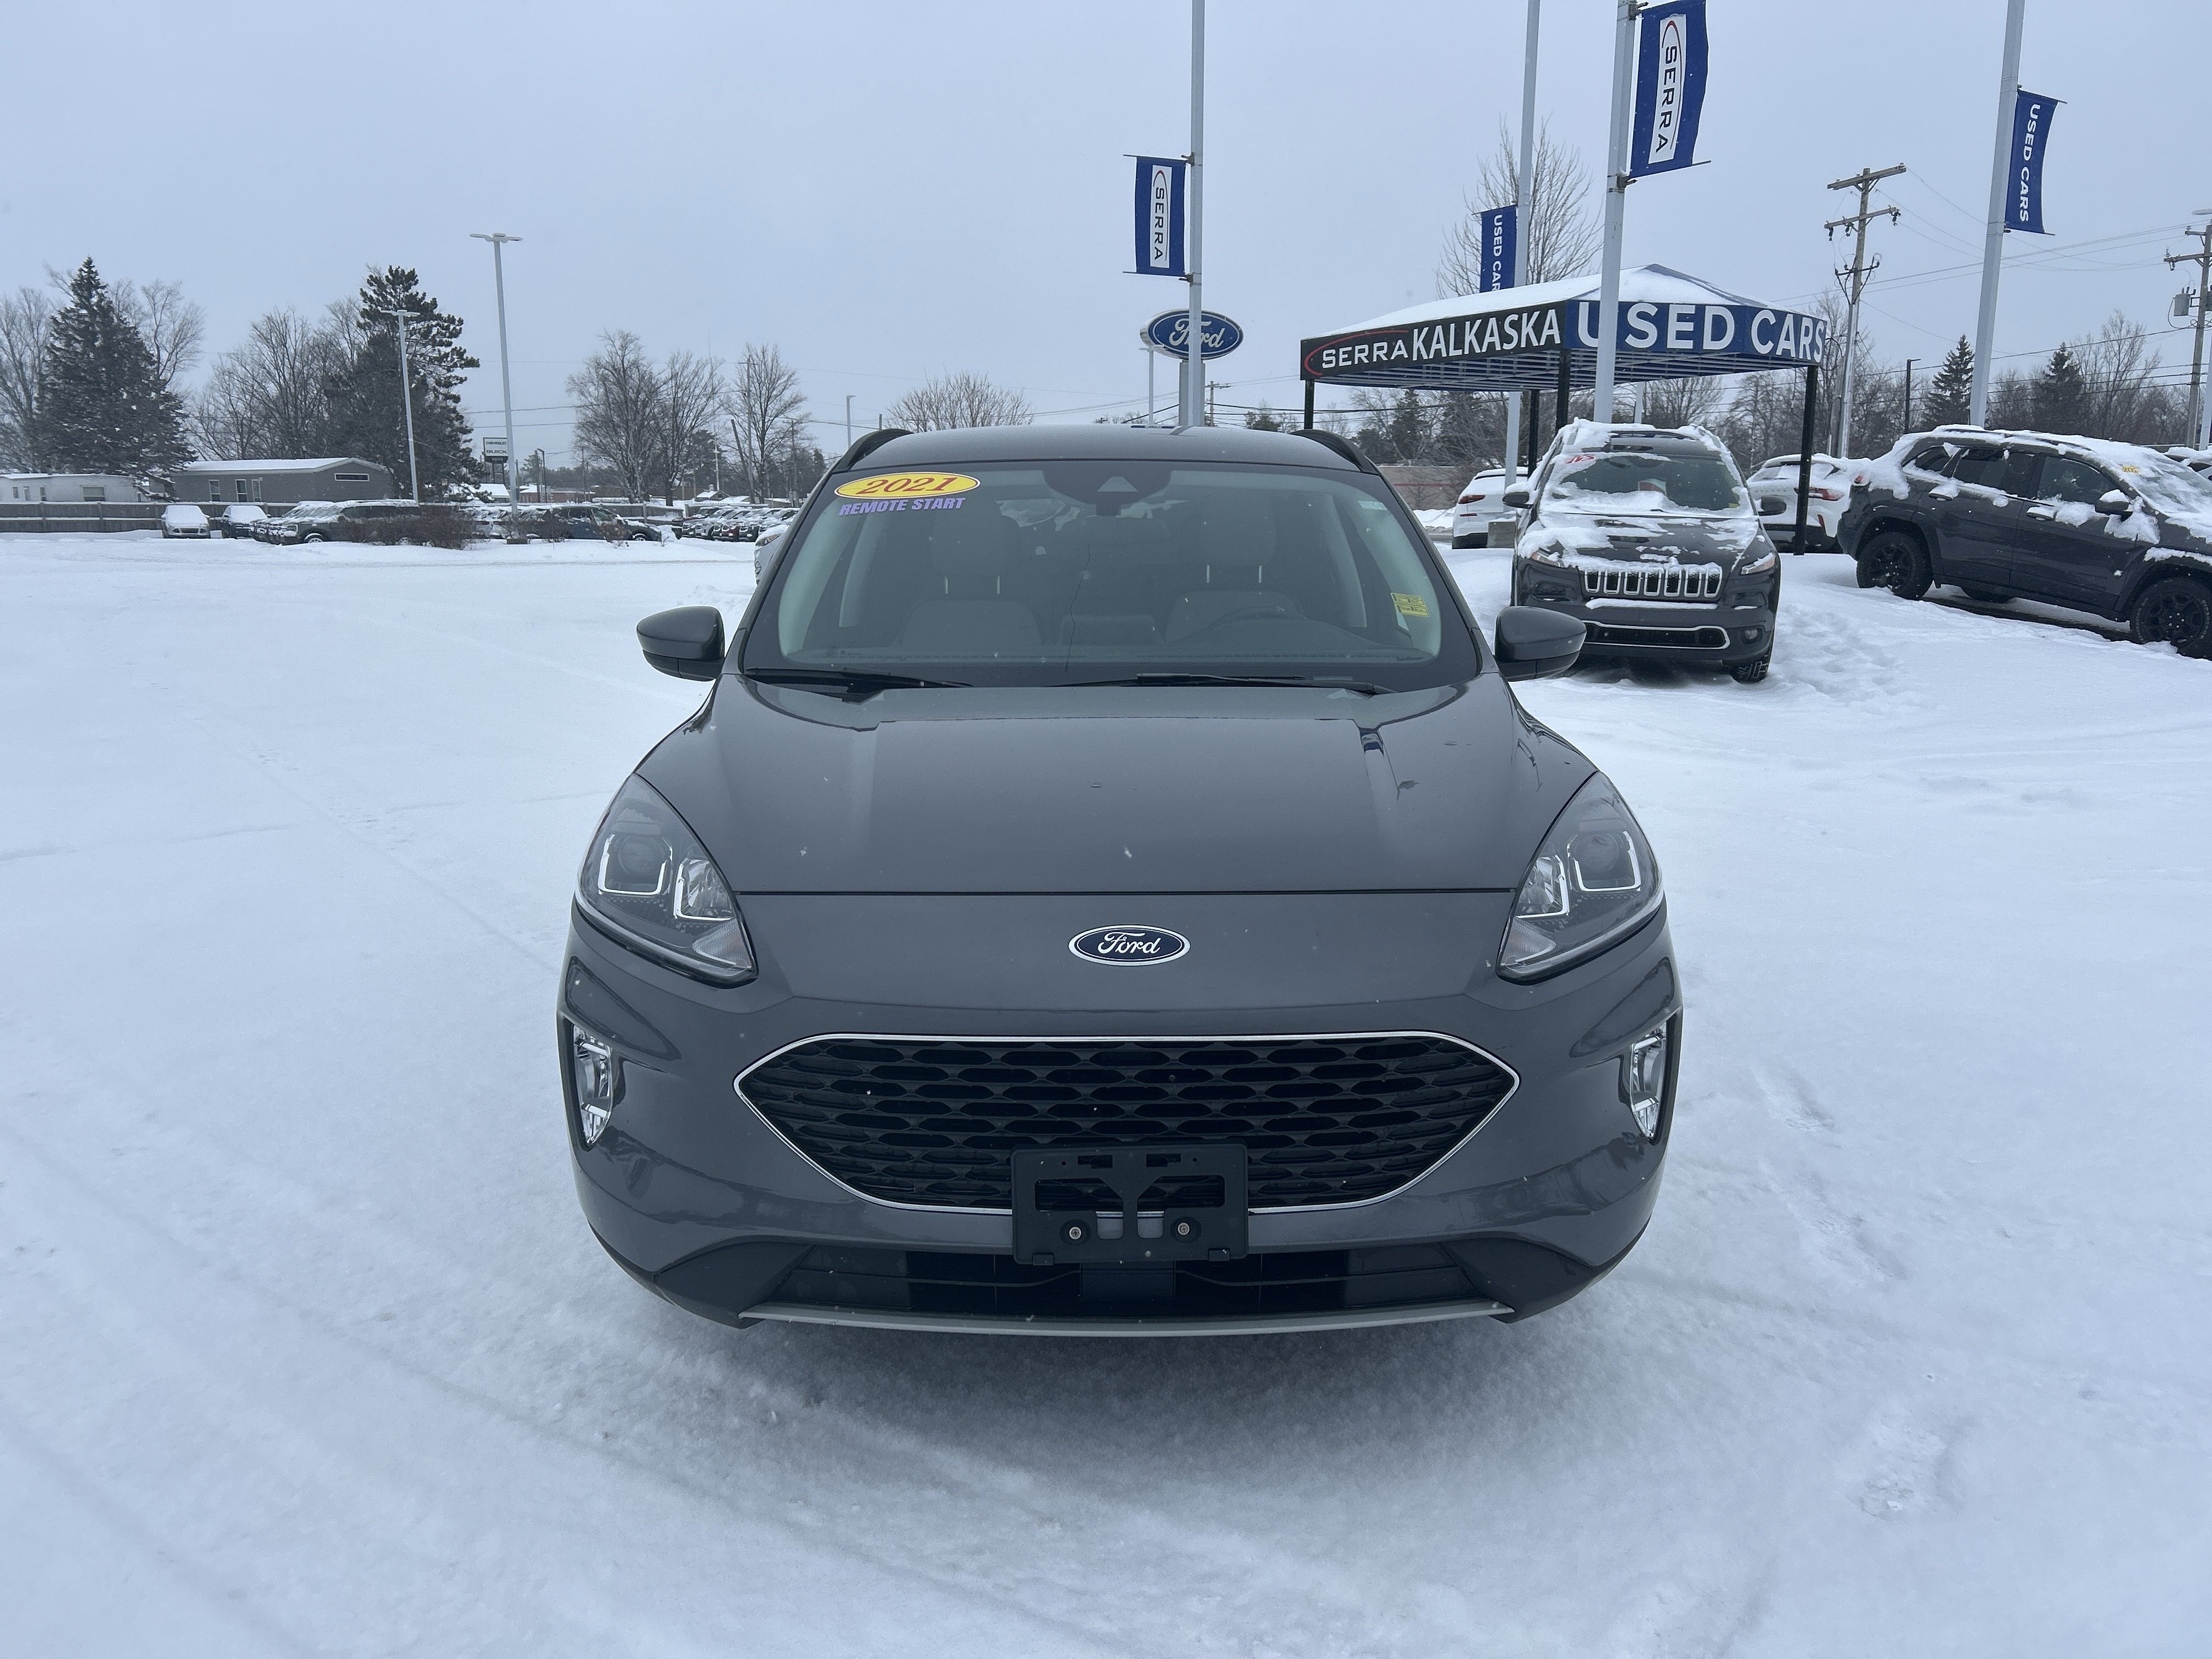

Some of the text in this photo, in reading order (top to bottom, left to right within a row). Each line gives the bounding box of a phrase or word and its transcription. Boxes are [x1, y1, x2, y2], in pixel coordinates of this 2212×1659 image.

[1656, 46, 1678, 153] SERRA
[2019, 103, 2041, 222] USED CARS
[1154, 187, 1165, 260] SERRA
[1492, 215, 1503, 291] USED CAR
[1169, 318, 1226, 348] Frd
[1322, 309, 1561, 369] SERRA KALKASKA
[1577, 302, 1827, 363] USED CARS
[839, 497, 966, 516] REMOTE START
[855, 477, 957, 494] 2021
[1097, 932, 1161, 953] Ford
